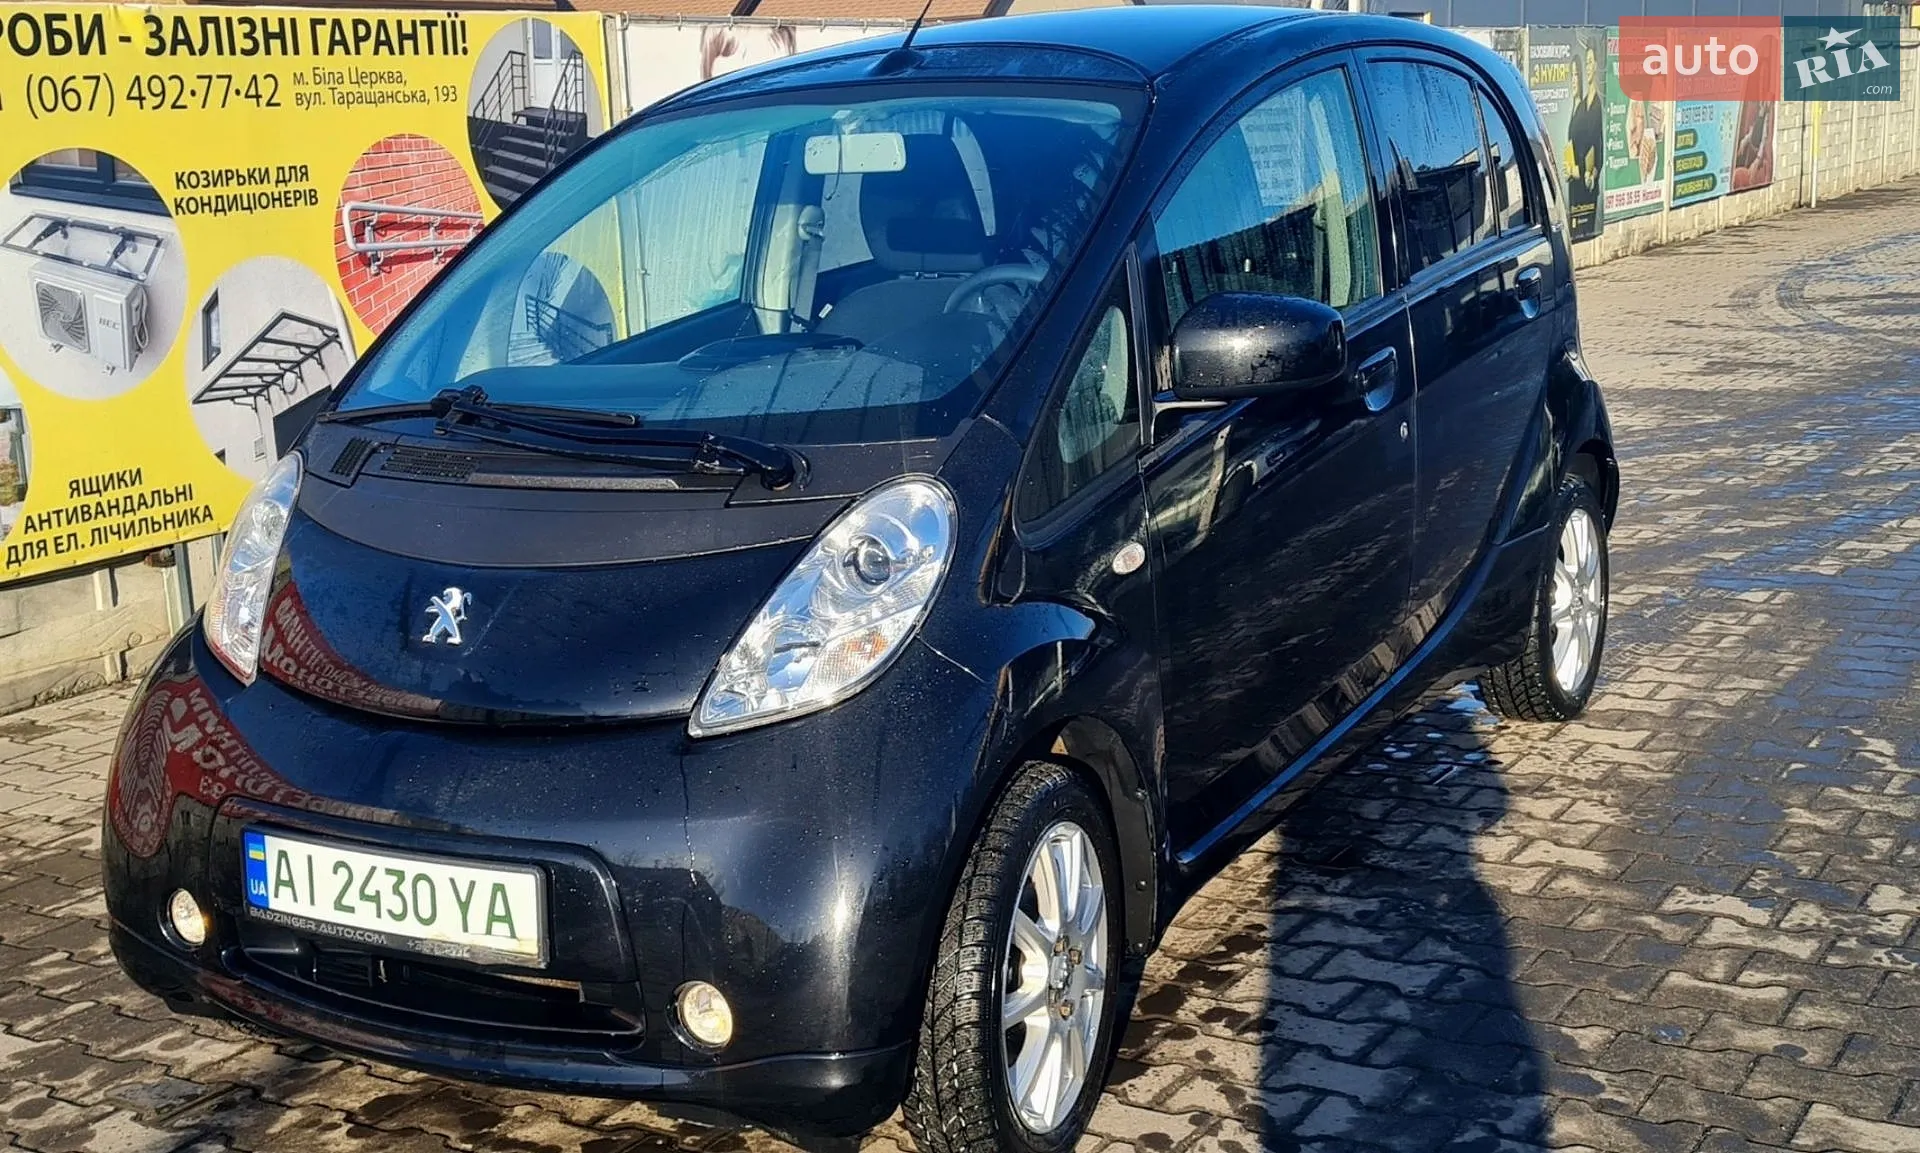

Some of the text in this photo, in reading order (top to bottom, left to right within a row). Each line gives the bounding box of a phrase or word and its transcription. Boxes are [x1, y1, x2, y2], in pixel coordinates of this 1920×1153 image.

[0, 12, 106, 56] ОБИ
[144, 14, 300, 56] ЗАЛІЗНІ
[310, 12, 468, 56] ГАРАНТІЇ!
[293, 67, 407, 89] м. Біла Церква,
[27, 73, 115, 119] (067)
[295, 85, 457, 110] вул. Таращанська, 193
[175, 165, 309, 190] КОЗИРЬКИ ДЛЯ
[174, 188, 319, 216] КОНДИЦІОНЕРІВ
[69, 467, 143, 499] ЯЩИКИ
[24, 484, 193, 534] АНТИВАНДАЛЬНІ
[6, 504, 213, 570] ДЛЯ ЕЛ. ЛІЧИЛЬНИКА
[251, 878, 267, 897] UA
[274, 849, 517, 939] AI 2430 YA
